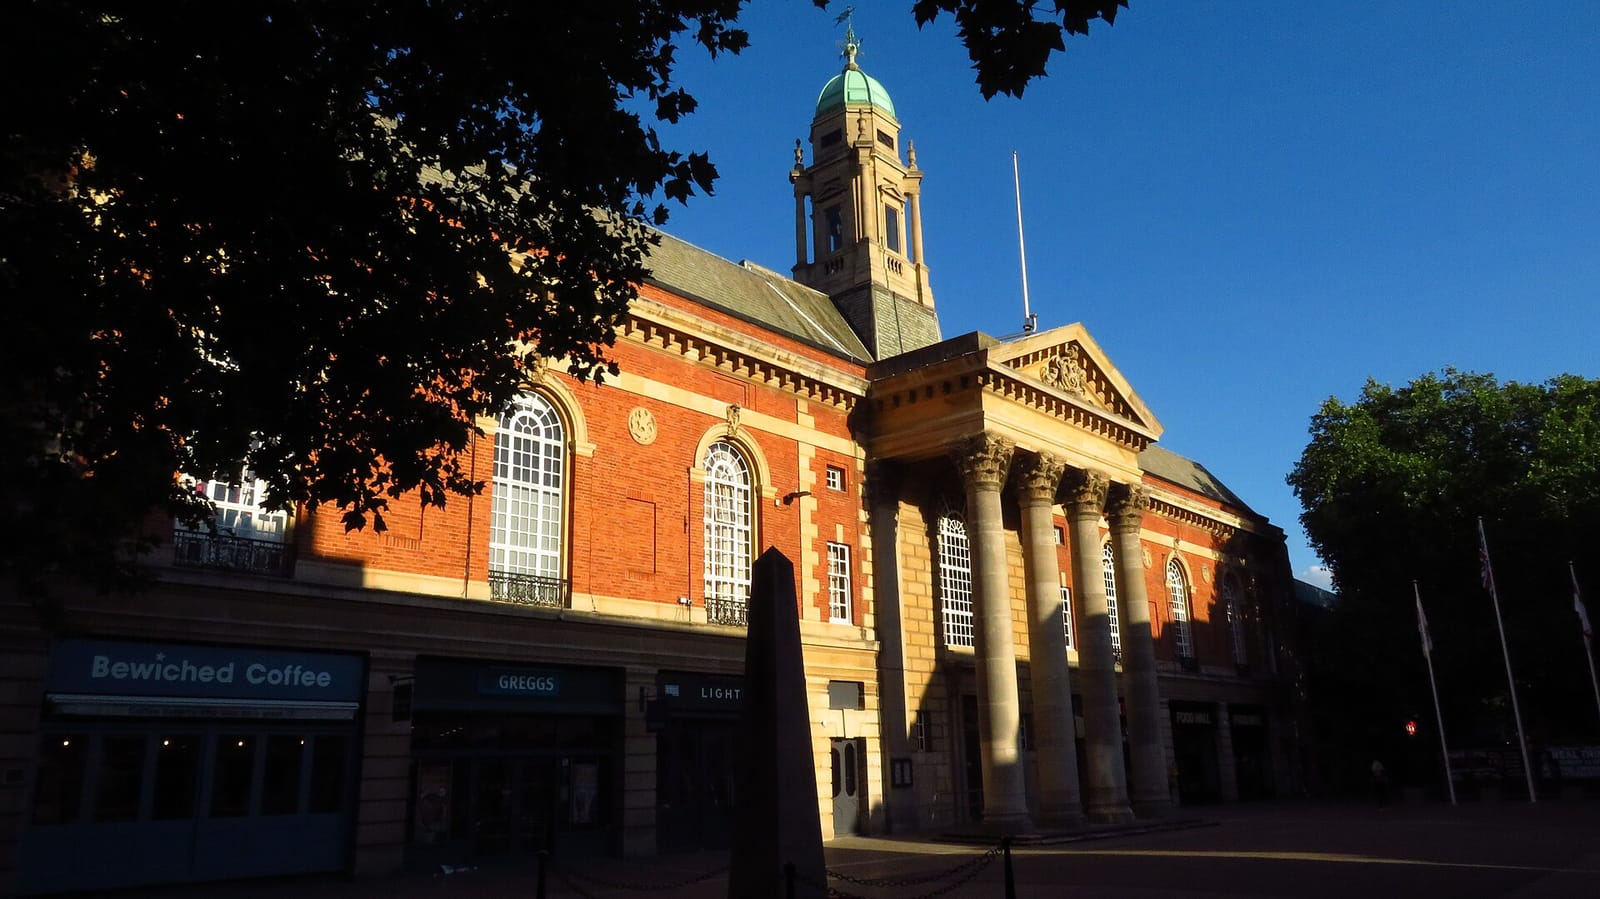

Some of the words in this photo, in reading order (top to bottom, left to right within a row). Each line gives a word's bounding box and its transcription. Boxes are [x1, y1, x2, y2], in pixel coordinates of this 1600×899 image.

[92, 653, 234, 684] Bewiched
[246, 663, 332, 687] Coffee
[499, 676, 554, 691] GREGGS
